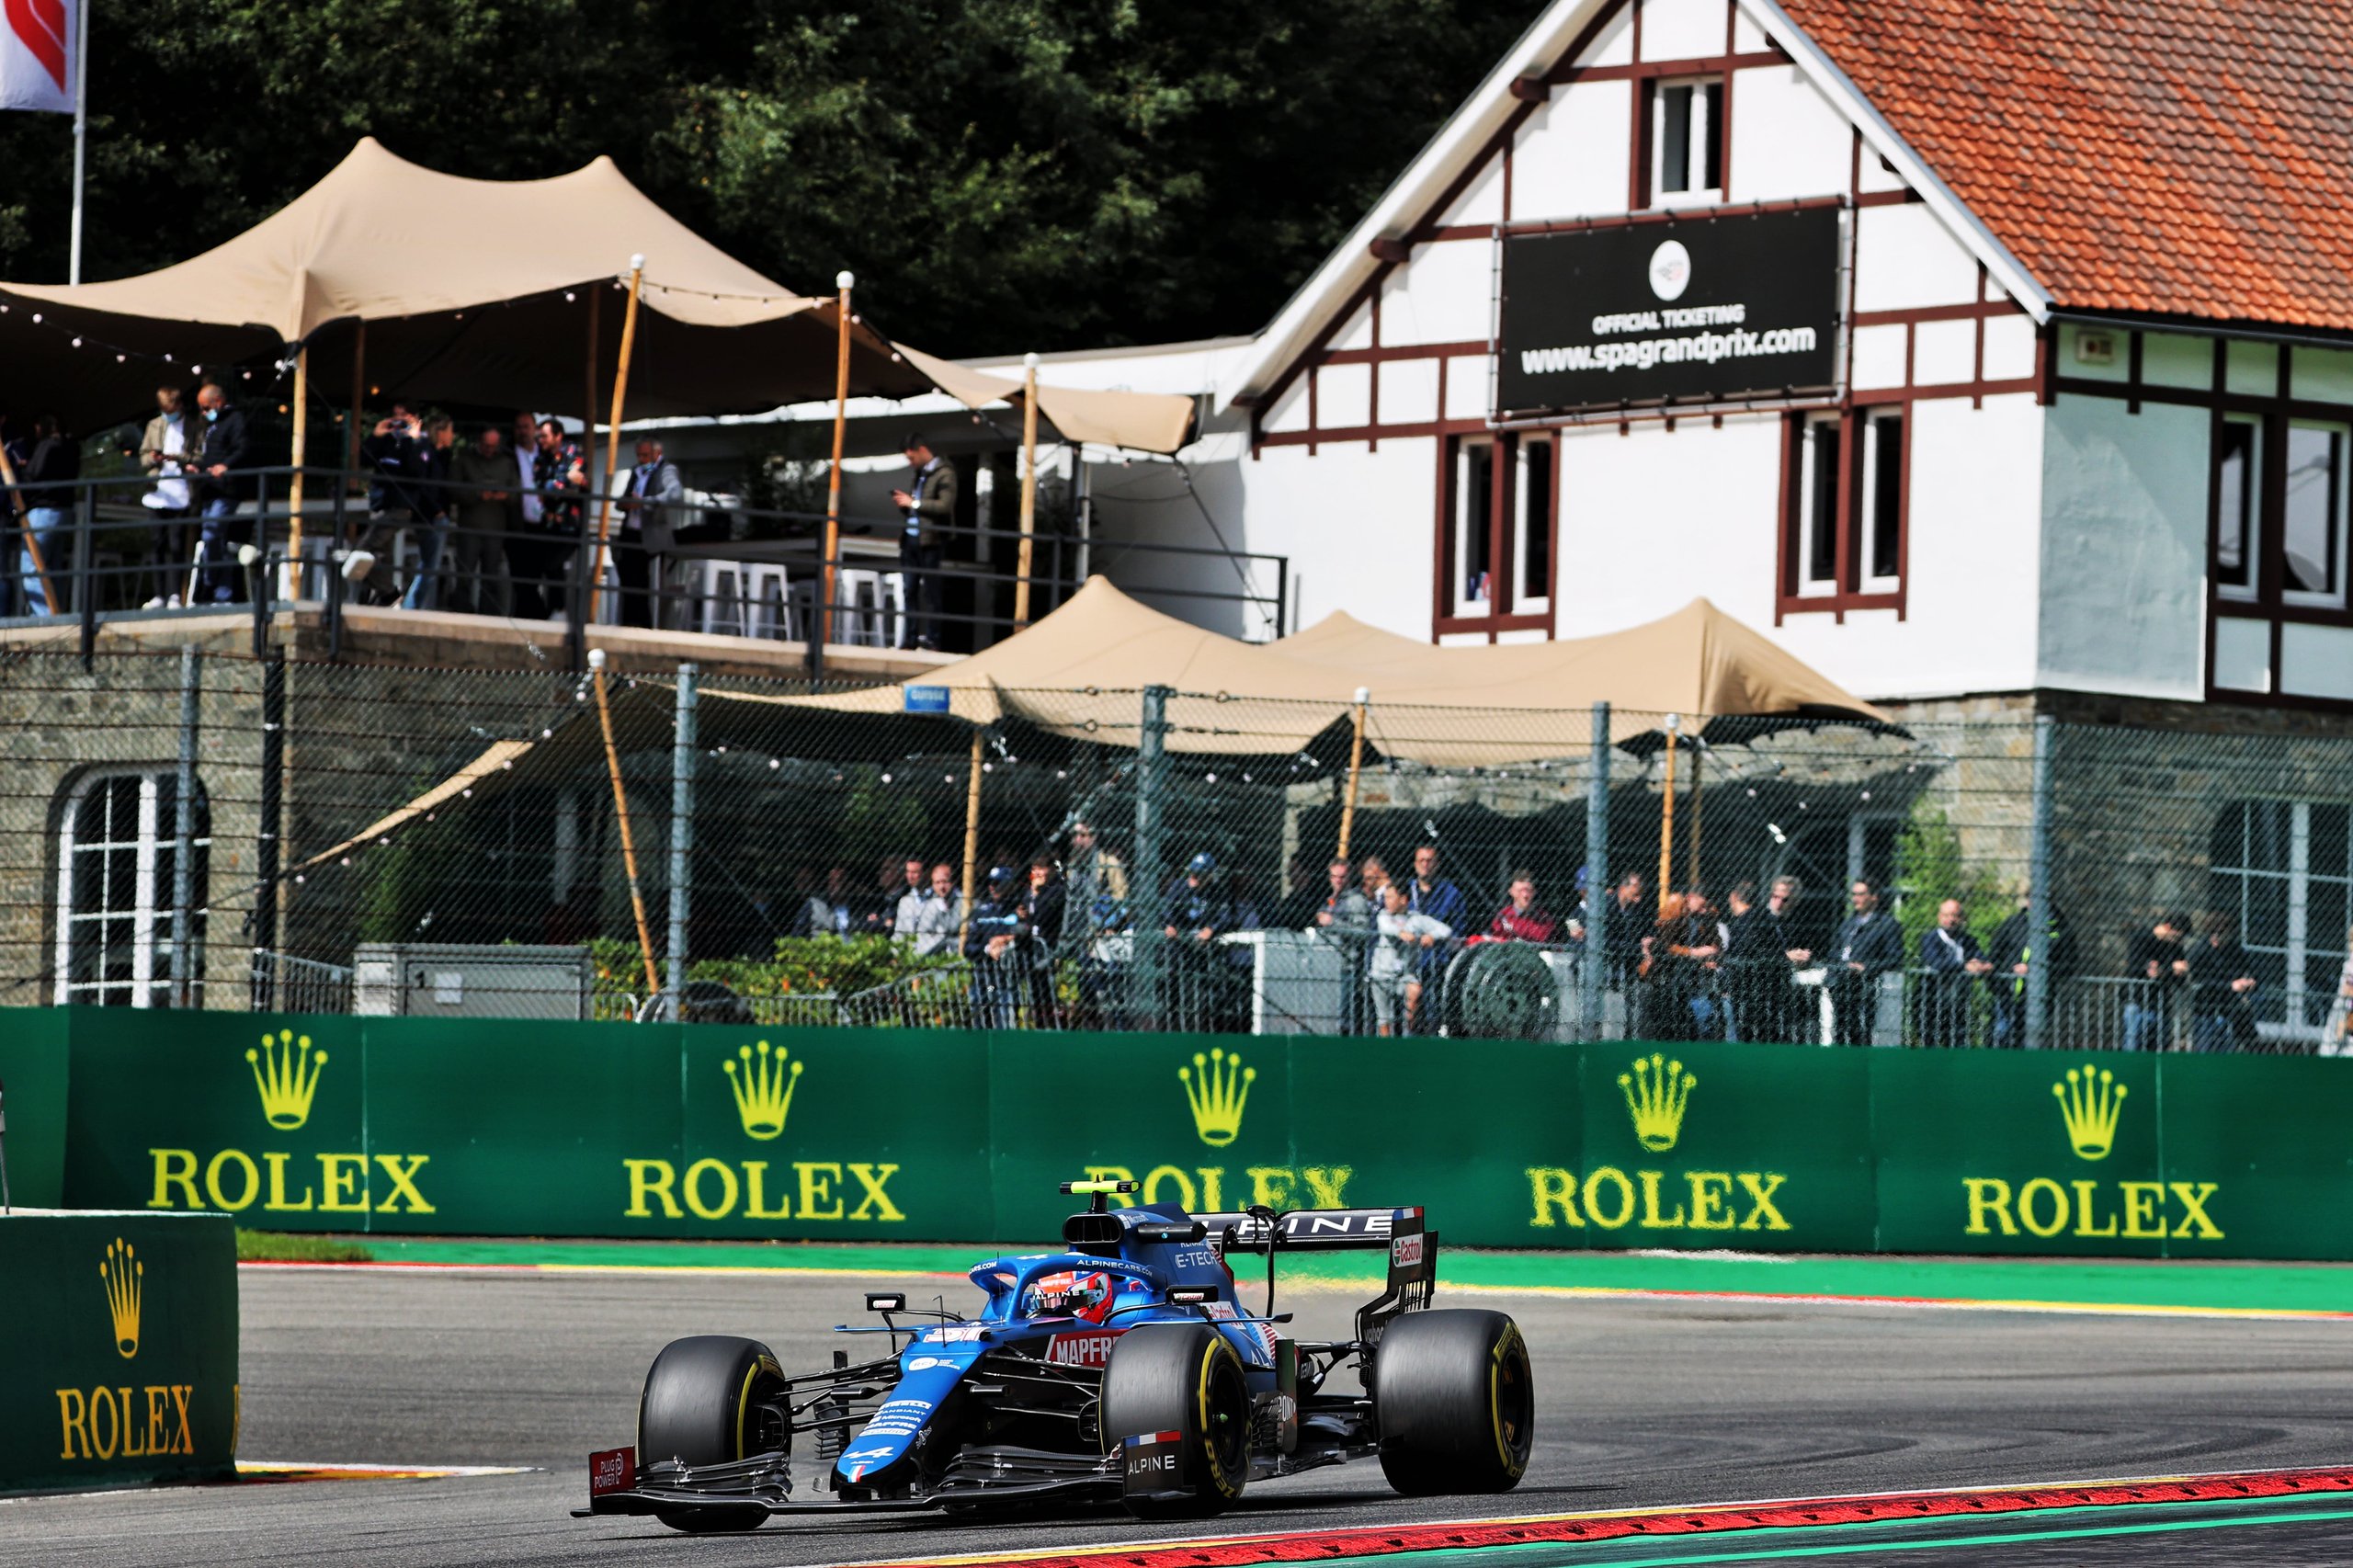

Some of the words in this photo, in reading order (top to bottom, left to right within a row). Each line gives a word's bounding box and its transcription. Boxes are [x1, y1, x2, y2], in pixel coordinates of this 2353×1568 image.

[1592, 312, 1660, 335] OFFICIAL
[1660, 304, 1745, 328] TICKETING
[1521, 327, 1815, 374] www.spagrandprix.com
[147, 1148, 436, 1214] ROLEX
[623, 1158, 906, 1221] ROLEX
[1084, 1164, 1353, 1213] ROLEX
[1529, 1166, 1791, 1230] ROLEX
[1962, 1177, 2224, 1240] ROLEX
[1199, 1215, 1393, 1236] LPINE
[1175, 1251, 1219, 1268] E-TECH
[1400, 1238, 1422, 1263] Castrol
[1076, 1258, 1154, 1278] ALPINECARS.COM
[56, 1383, 195, 1461] ROLEX
[594, 1472, 616, 1489] POWER
[600, 1459, 615, 1473] PLUG
[1127, 1454, 1176, 1476] ALPINE
